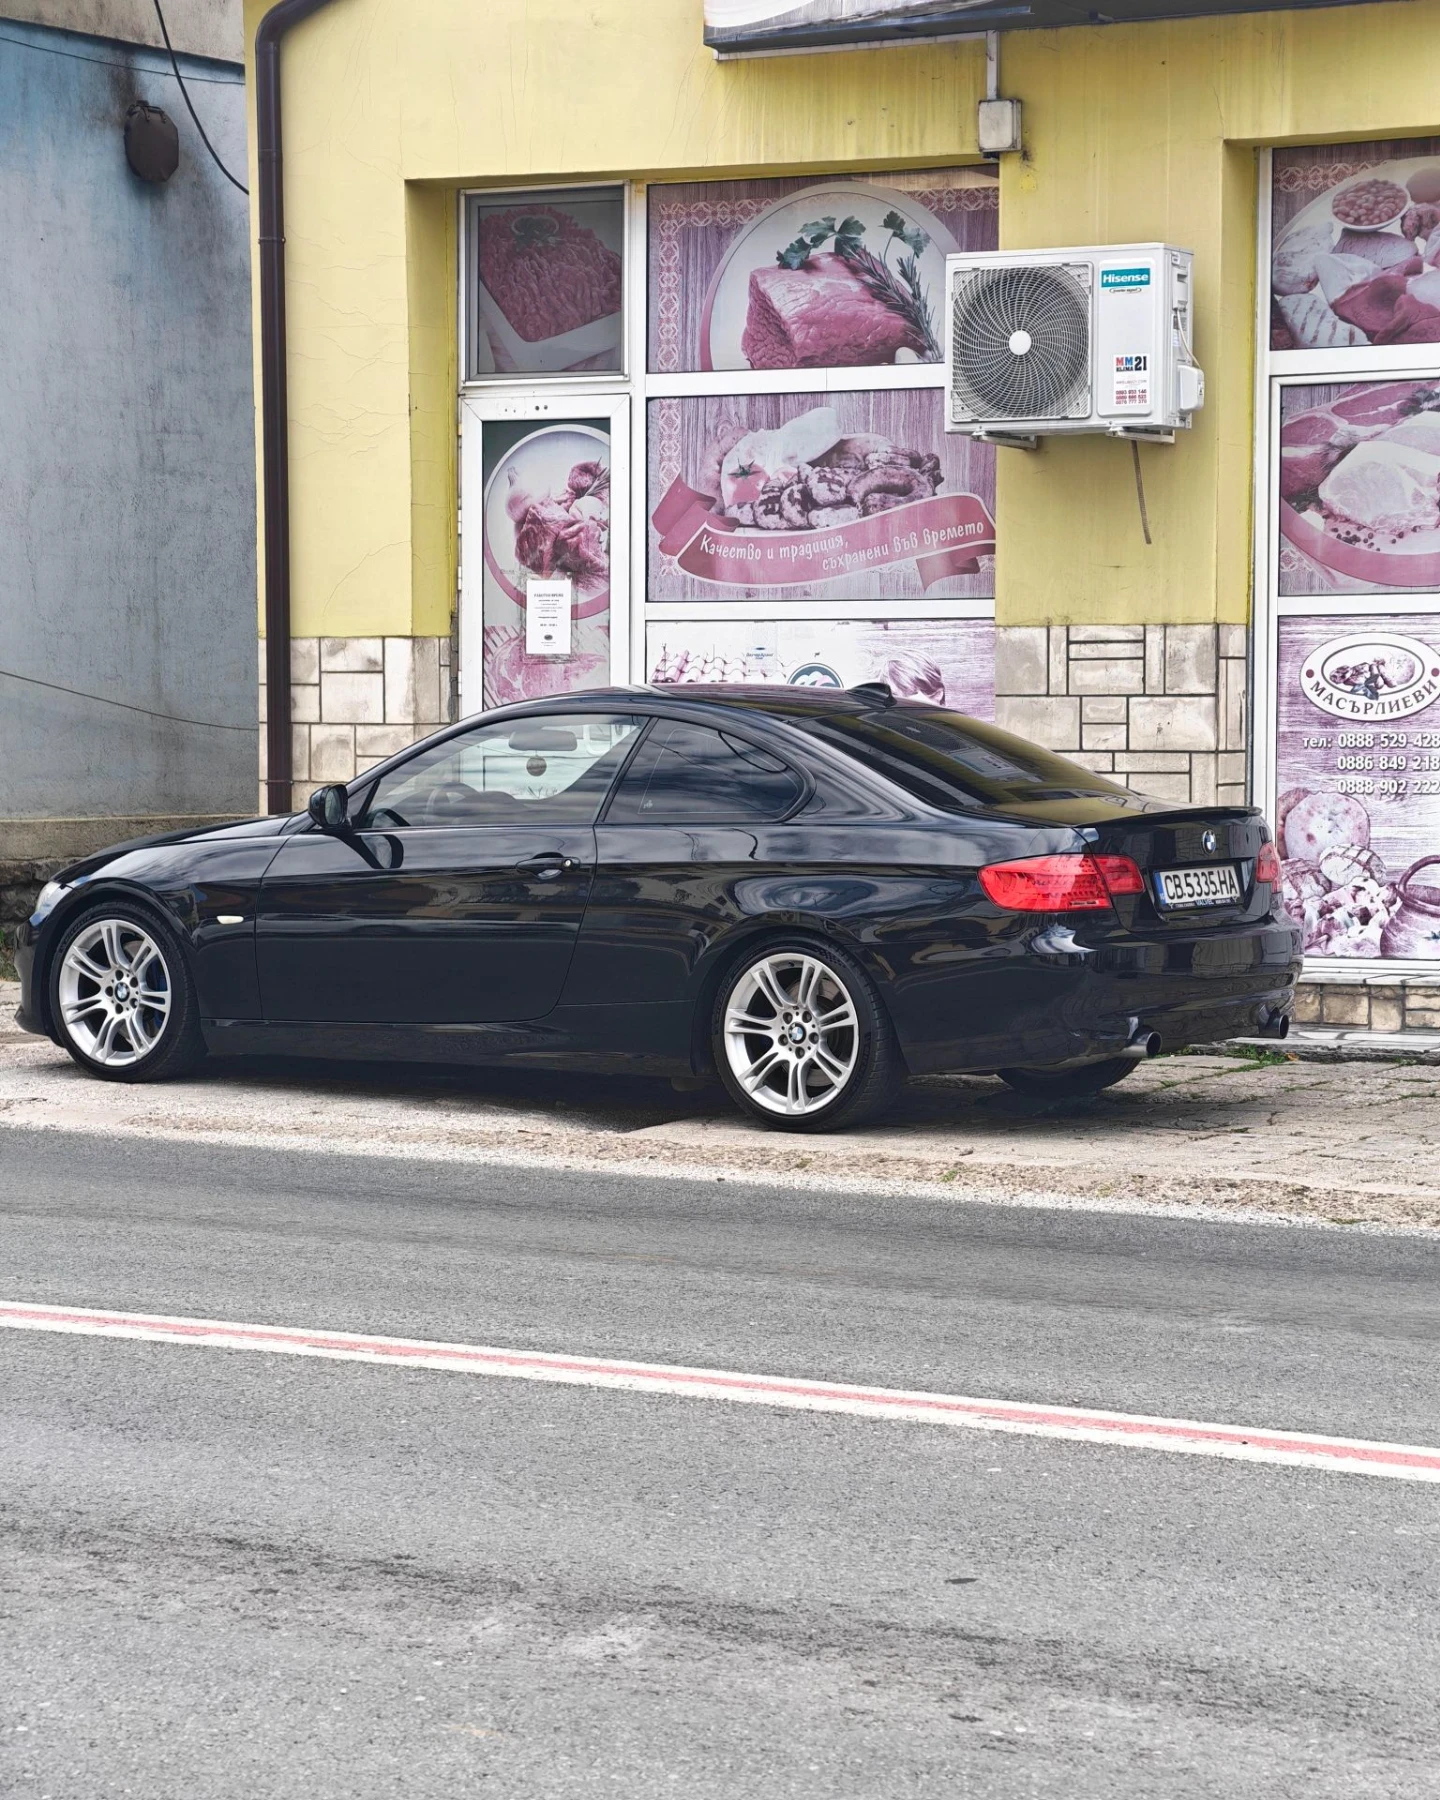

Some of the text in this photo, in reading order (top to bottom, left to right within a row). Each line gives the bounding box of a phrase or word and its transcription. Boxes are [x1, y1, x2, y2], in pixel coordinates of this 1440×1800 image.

[1103, 273, 1149, 284] Hisense
[1134, 355, 1147, 371] 21
[700, 534, 849, 562] Качество и традиция,
[822, 521, 984, 570] съхранени във времето
[1310, 679, 1438, 715] МАСЪРЛИЕВИ
[1303, 733, 1440, 748] тел: 0888 529 428
[1337, 755, 1440, 770] 0886 849 218
[1337, 779, 1440, 794] 0888 902 222
